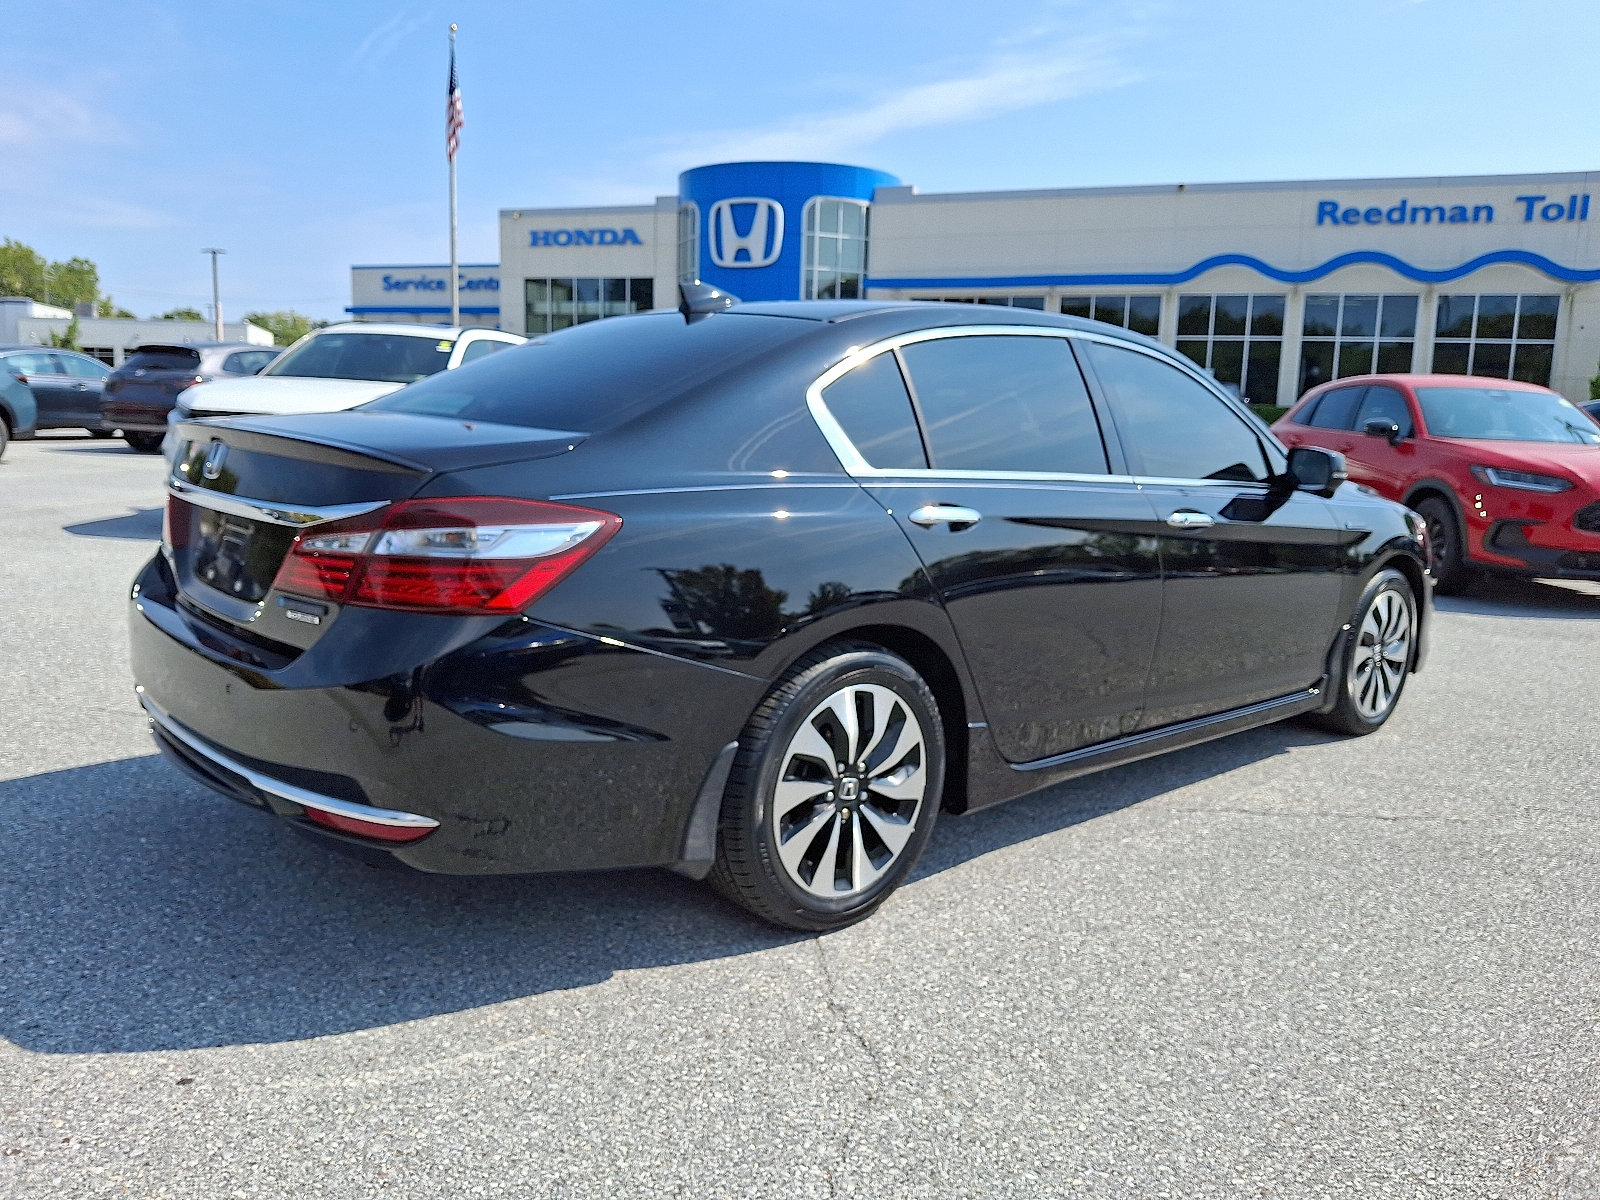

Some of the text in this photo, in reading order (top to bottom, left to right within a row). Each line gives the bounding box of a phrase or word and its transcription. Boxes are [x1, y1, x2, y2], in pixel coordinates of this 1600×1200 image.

[1317, 194, 1590, 225] Reedman Toll
[529, 229, 643, 247] HONDA
[383, 274, 499, 291] Service Cent
